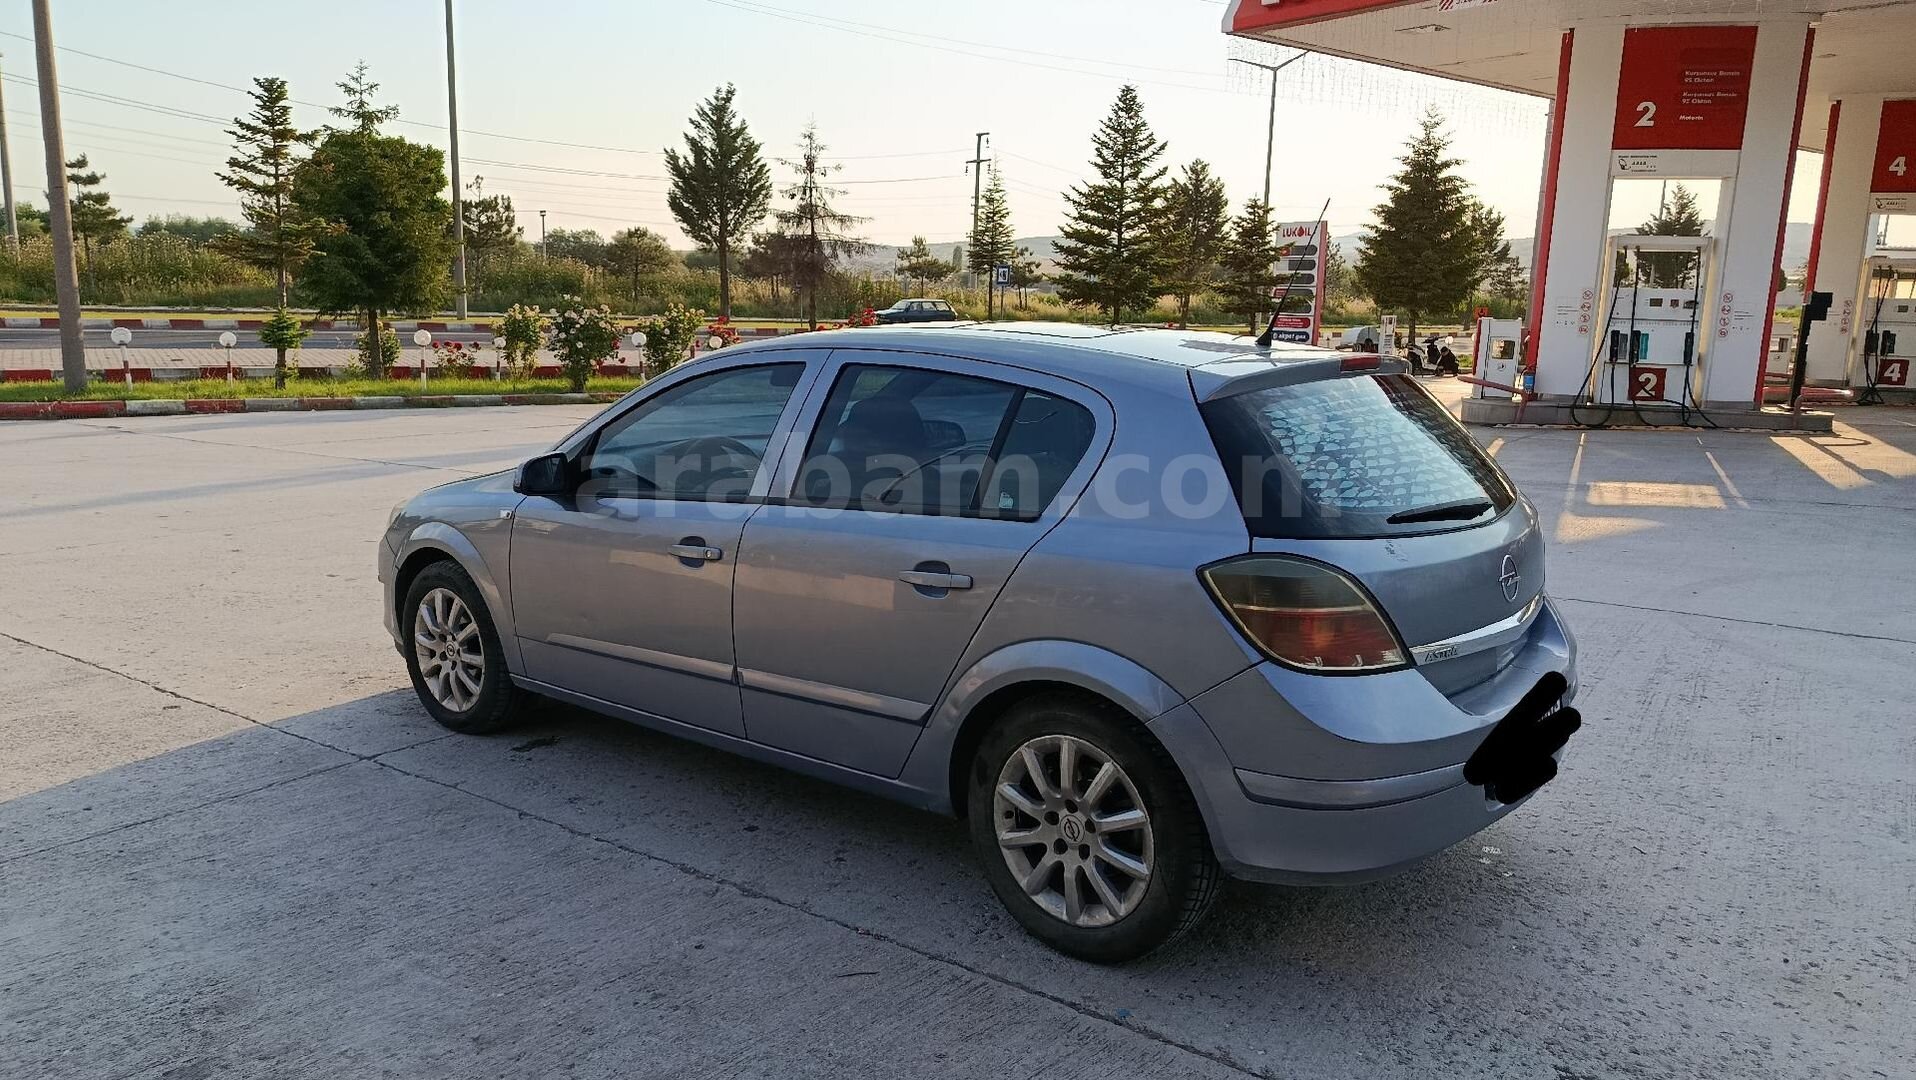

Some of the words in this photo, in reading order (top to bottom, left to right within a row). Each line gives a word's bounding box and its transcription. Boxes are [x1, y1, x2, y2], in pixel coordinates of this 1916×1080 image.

[1633, 101, 1656, 127] 2
[1888, 156, 1906, 176] 4
[1282, 226, 1311, 238] LUKOIL
[1884, 363, 1901, 382] 4
[1635, 373, 1658, 397] 2
